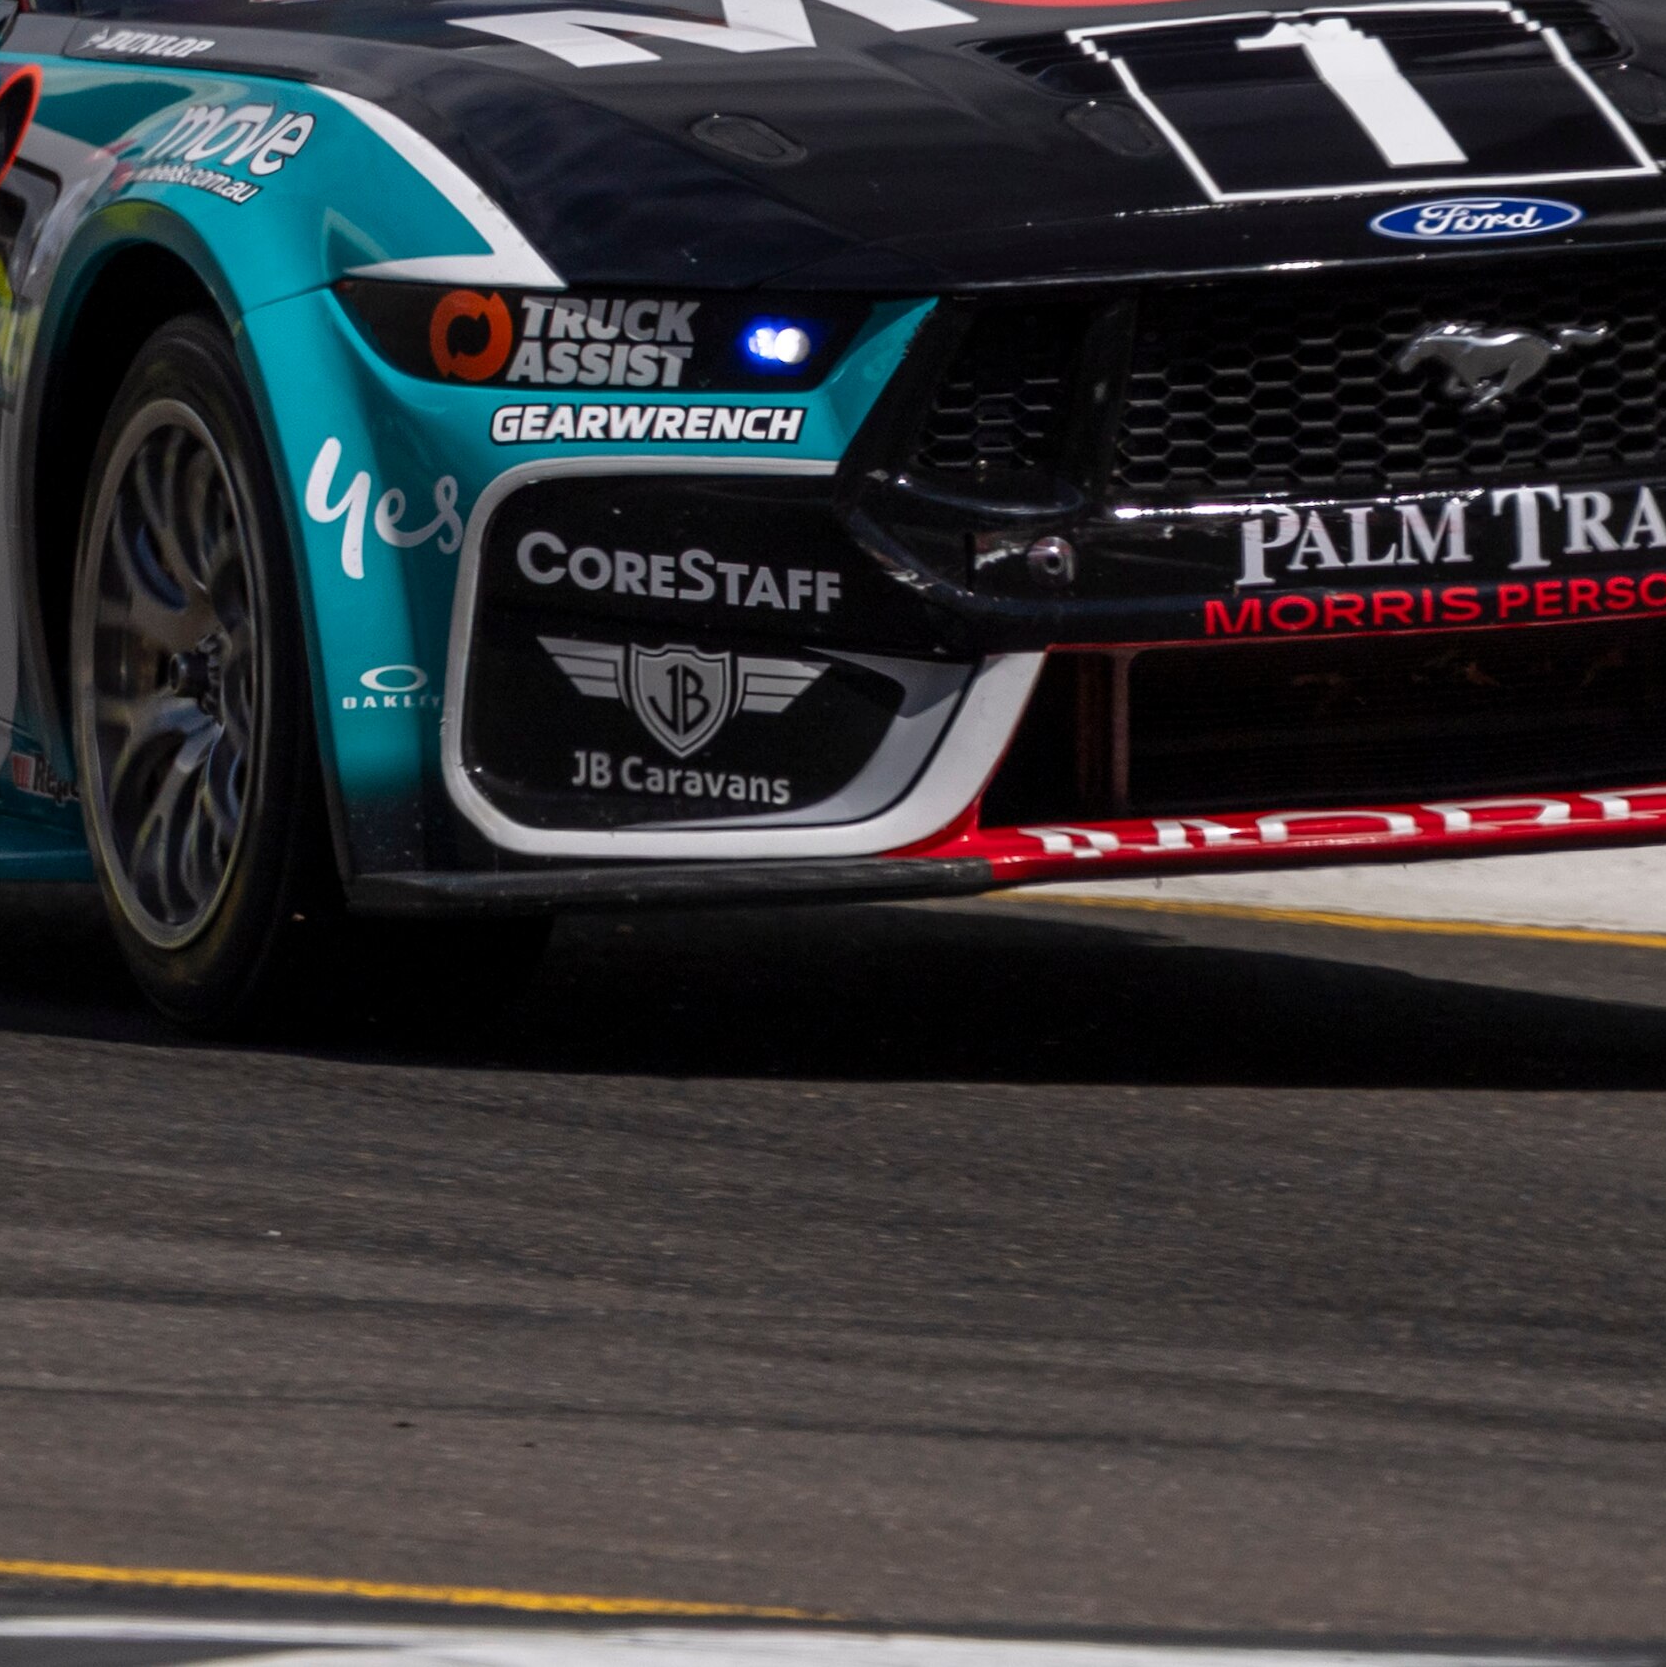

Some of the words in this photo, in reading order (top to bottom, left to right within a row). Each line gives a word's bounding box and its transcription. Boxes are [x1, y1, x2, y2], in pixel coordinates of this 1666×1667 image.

[99, 29, 216, 58] DUNLOP
[1413, 202, 1543, 235] Ford
[520, 295, 700, 344] TRUCK
[507, 343, 693, 388] ASSIST
[491, 404, 804, 442] GEARWRENCH
[1203, 586, 1482, 635] MORRIS
[571, 750, 612, 788] JB
[620, 755, 791, 805] Caravans
